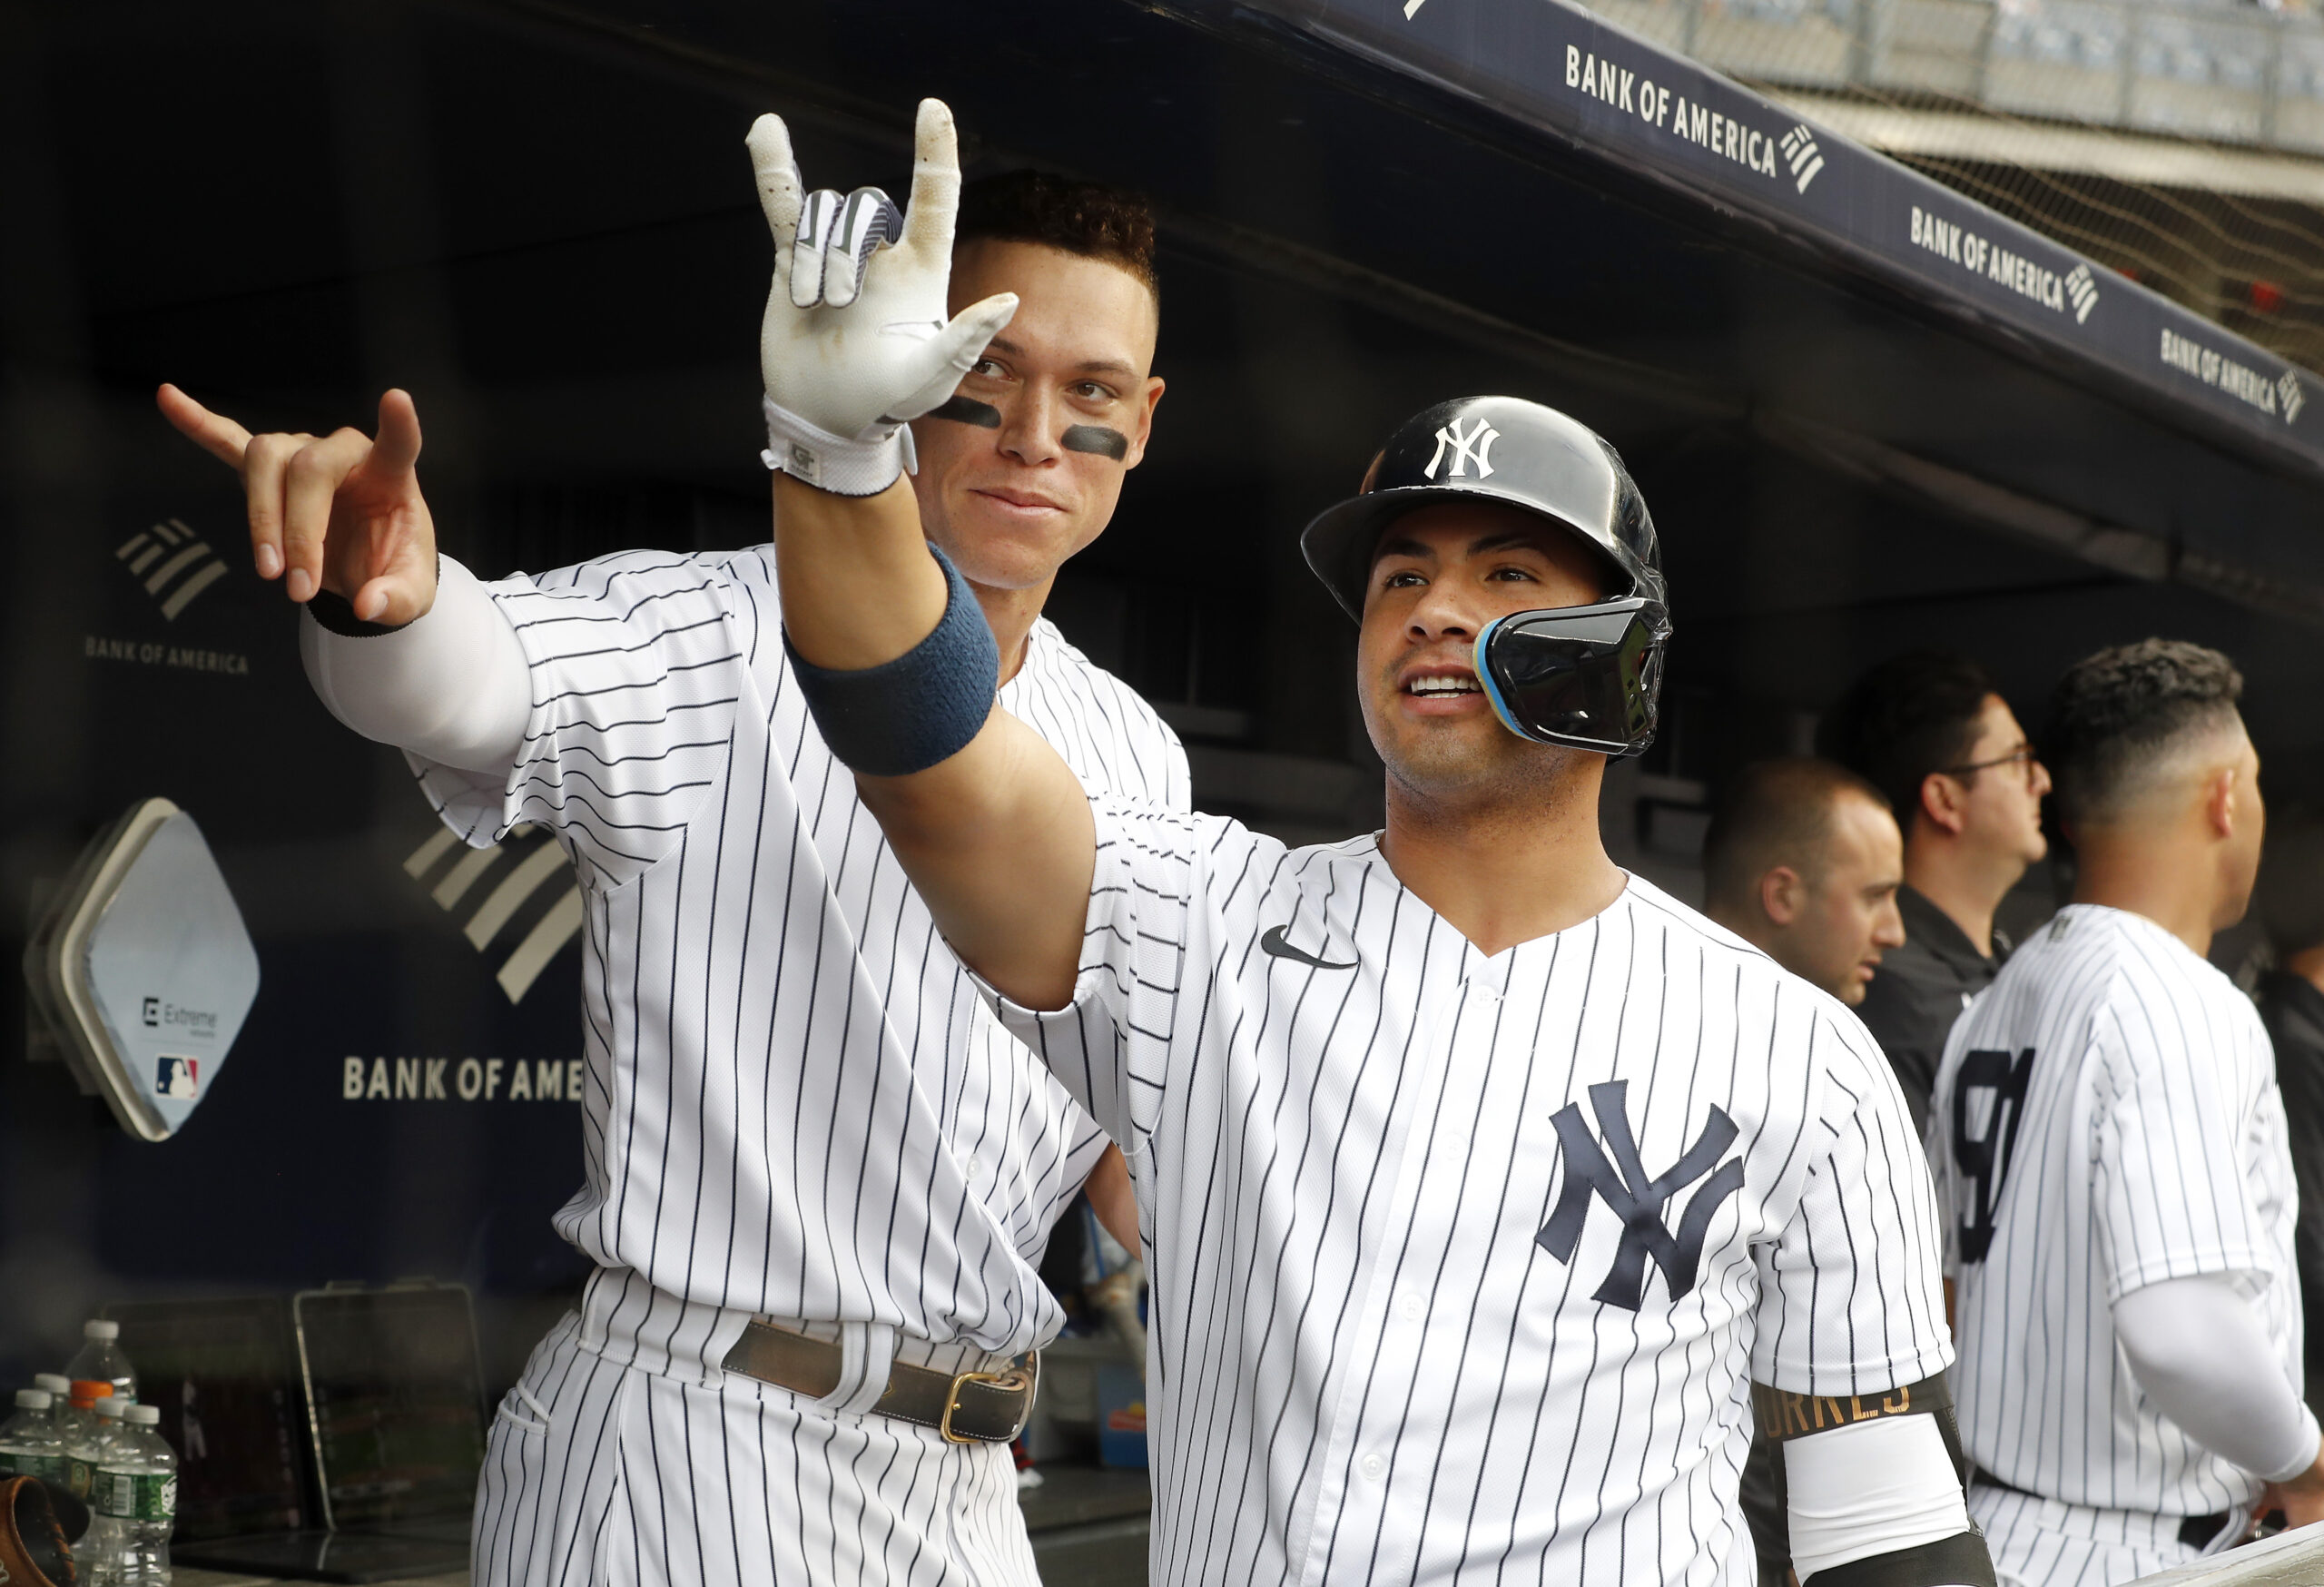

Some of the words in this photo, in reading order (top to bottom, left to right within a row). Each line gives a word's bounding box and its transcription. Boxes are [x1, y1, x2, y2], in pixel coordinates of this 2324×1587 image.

[1566, 44, 1634, 113] BANK
[1640, 80, 1670, 128] OF
[1673, 96, 1777, 178] AMERICA
[1910, 205, 1962, 264] BANK
[1964, 232, 1989, 274] OF
[1988, 245, 2064, 312] AMERICA
[2161, 328, 2201, 379] BANK
[2201, 348, 2221, 386] OF
[2219, 358, 2276, 416] AMERICA
[1423, 417, 1501, 480] NY
[85, 636, 136, 662] BANK
[140, 643, 163, 665] OF
[167, 647, 249, 675] AMERICA
[343, 1056, 448, 1100] BANK
[457, 1057, 504, 1101] OF
[1534, 1079, 1745, 1312] NY
